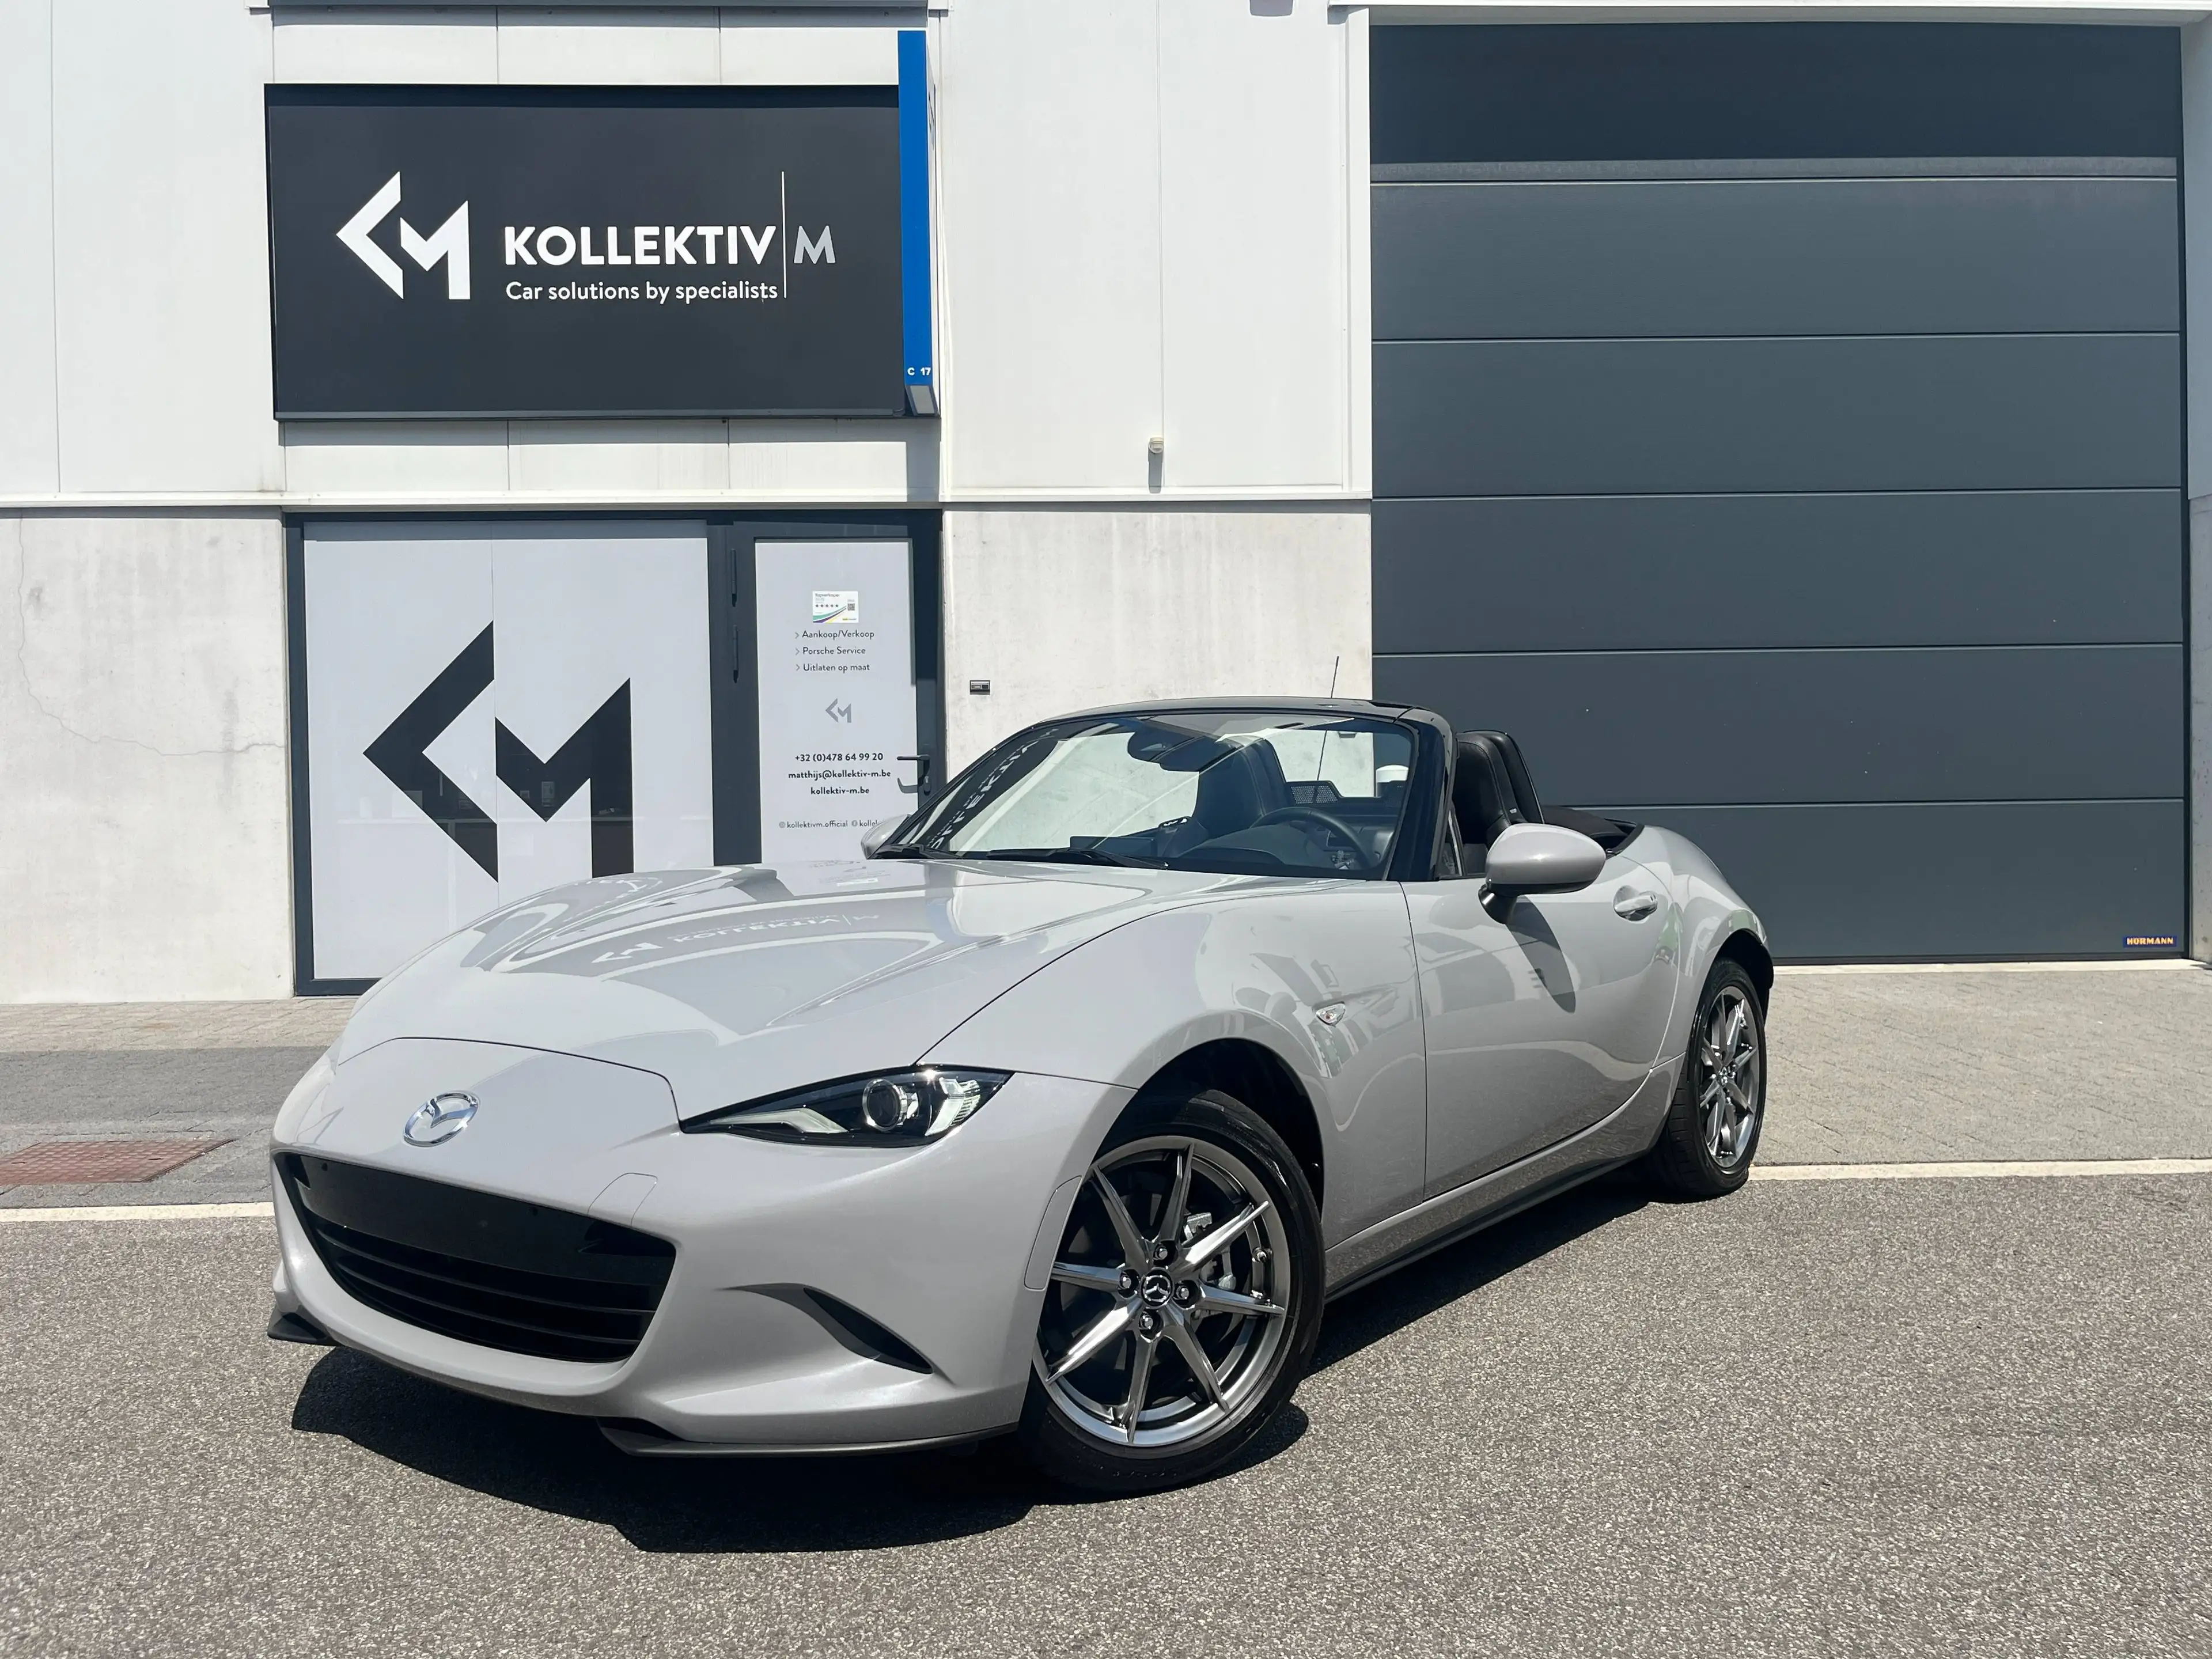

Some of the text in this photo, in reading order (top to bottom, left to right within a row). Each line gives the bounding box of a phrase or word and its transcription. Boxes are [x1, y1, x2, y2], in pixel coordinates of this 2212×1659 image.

[505, 225, 836, 266] KOLLEKTIV M
[506, 280, 778, 305] Car solutions by specialists
[907, 367, 931, 376] C 17
[802, 629, 874, 640] Aankoop/Verkoop
[802, 646, 866, 655] Porsche Service
[803, 663, 836, 672] Uitlaten
[838, 665, 848, 673] op
[795, 752, 884, 762] +32 (0)478 64 99 20
[788, 769, 891, 781] matthijs@kollektiv-m.be
[810, 786, 870, 795] kollektiv-m.be
[787, 820, 848, 828] kollektivm.official
